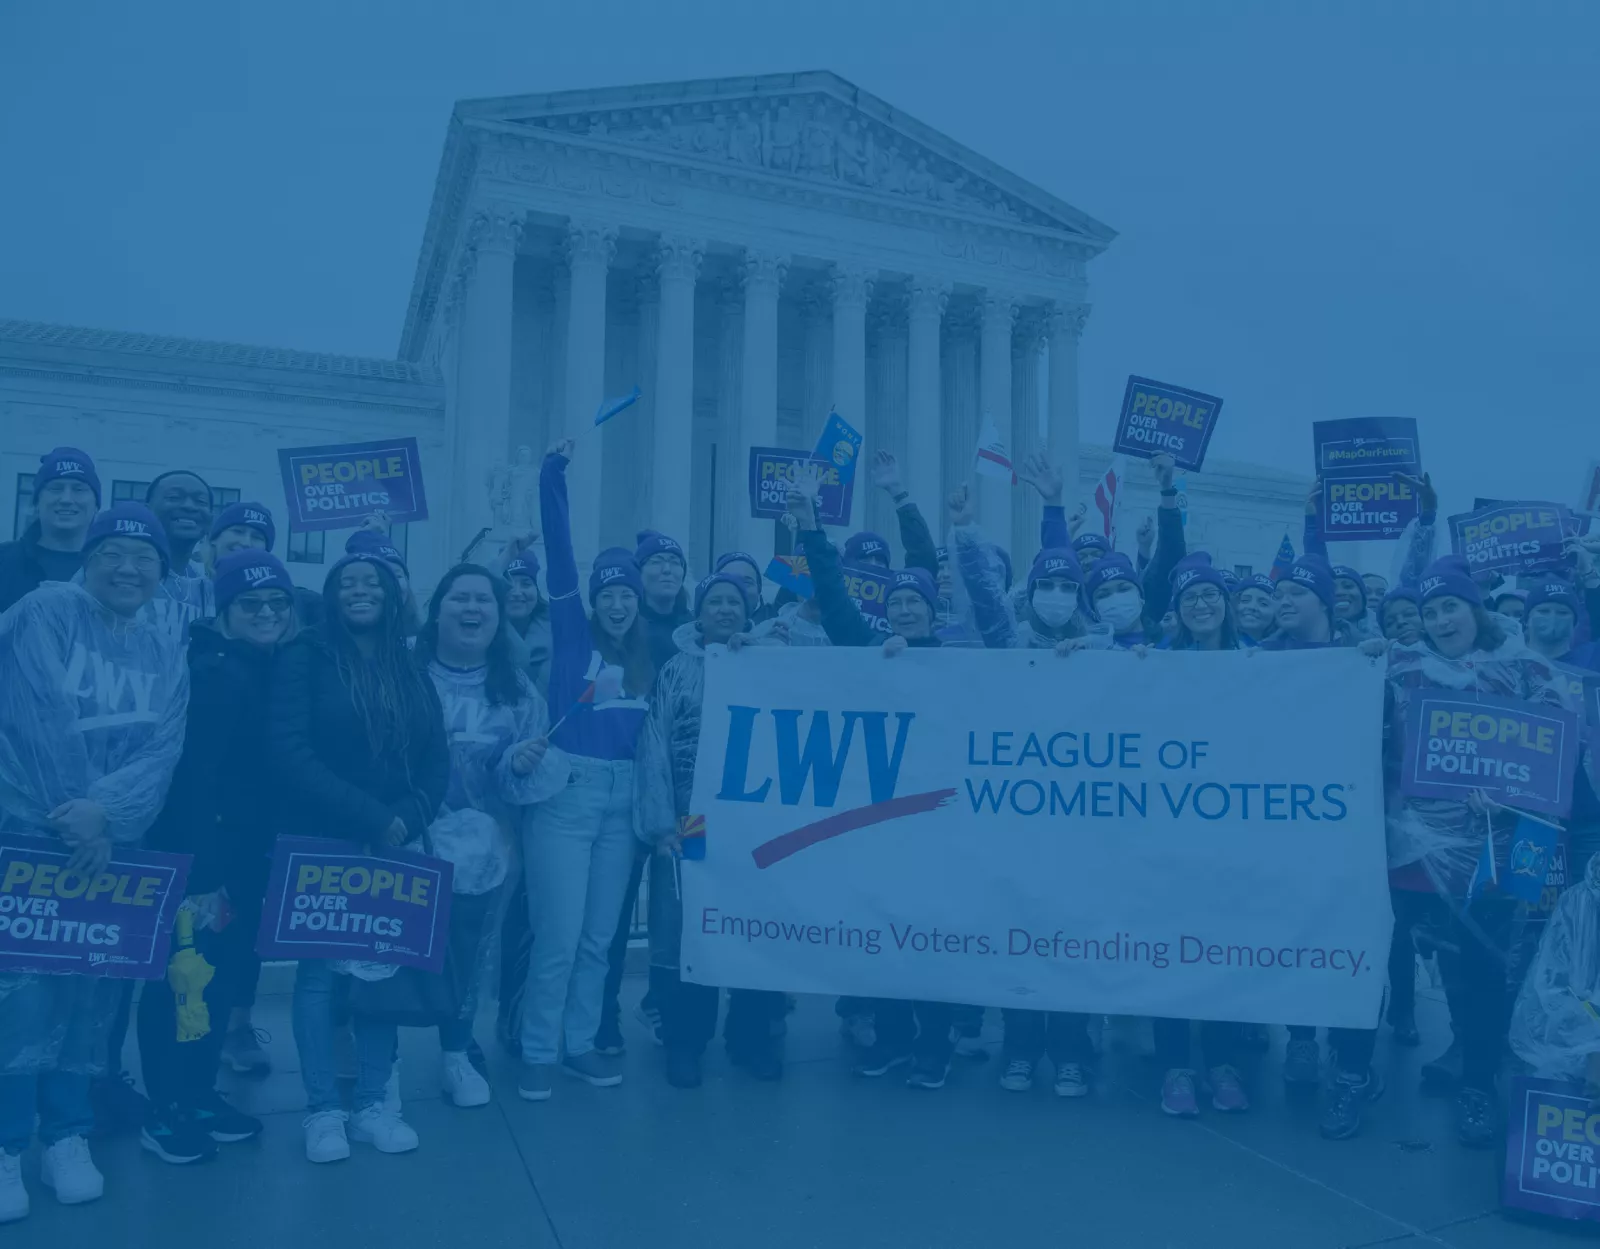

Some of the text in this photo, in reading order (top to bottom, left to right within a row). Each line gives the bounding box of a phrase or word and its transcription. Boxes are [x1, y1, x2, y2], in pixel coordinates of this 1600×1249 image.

[1132, 392, 1207, 430] PEOPLE
[1130, 414, 1158, 429] OVER
[1126, 426, 1185, 450] POLITICS
[1329, 448, 1409, 460] #MapOurFuture
[56, 461, 80, 471] LWV
[300, 457, 404, 485] PEOPLE
[304, 483, 345, 497] OVER
[1331, 483, 1412, 502] PEOPLE
[305, 492, 390, 512] POLITICS
[1331, 502, 1364, 512] OVER
[244, 509, 267, 521] LWV
[1331, 511, 1398, 525] POLITICS
[115, 520, 147, 533] LWV
[1464, 512, 1555, 543] PEOPLE
[1466, 536, 1499, 553] OVER
[1466, 540, 1540, 563] POLITICS
[600, 567, 622, 580] LWV
[1045, 559, 1067, 569] LWV
[1101, 567, 1120, 578] LWV
[1292, 566, 1315, 580] LWV
[244, 567, 272, 581] LWV
[896, 574, 916, 582] LWV
[1429, 710, 1555, 755] PEOPLE
[968, 730, 1210, 770] LEAGUE OF
[1428, 737, 1478, 755] OVER
[715, 705, 916, 808] LWV
[1425, 754, 1531, 782] POLITICS
[965, 778, 1147, 818] WOMEN
[1, 861, 161, 906] PEOPLE
[296, 864, 431, 907] PEOPLE
[0, 895, 59, 917] OVER
[294, 894, 348, 911] OVER
[289, 911, 404, 937] POLITICS
[701, 907, 1371, 977] Empowering Voters. Defending Democracy.
[1536, 1138, 1594, 1164] OVER
[1532, 1157, 1600, 1188] POLI
